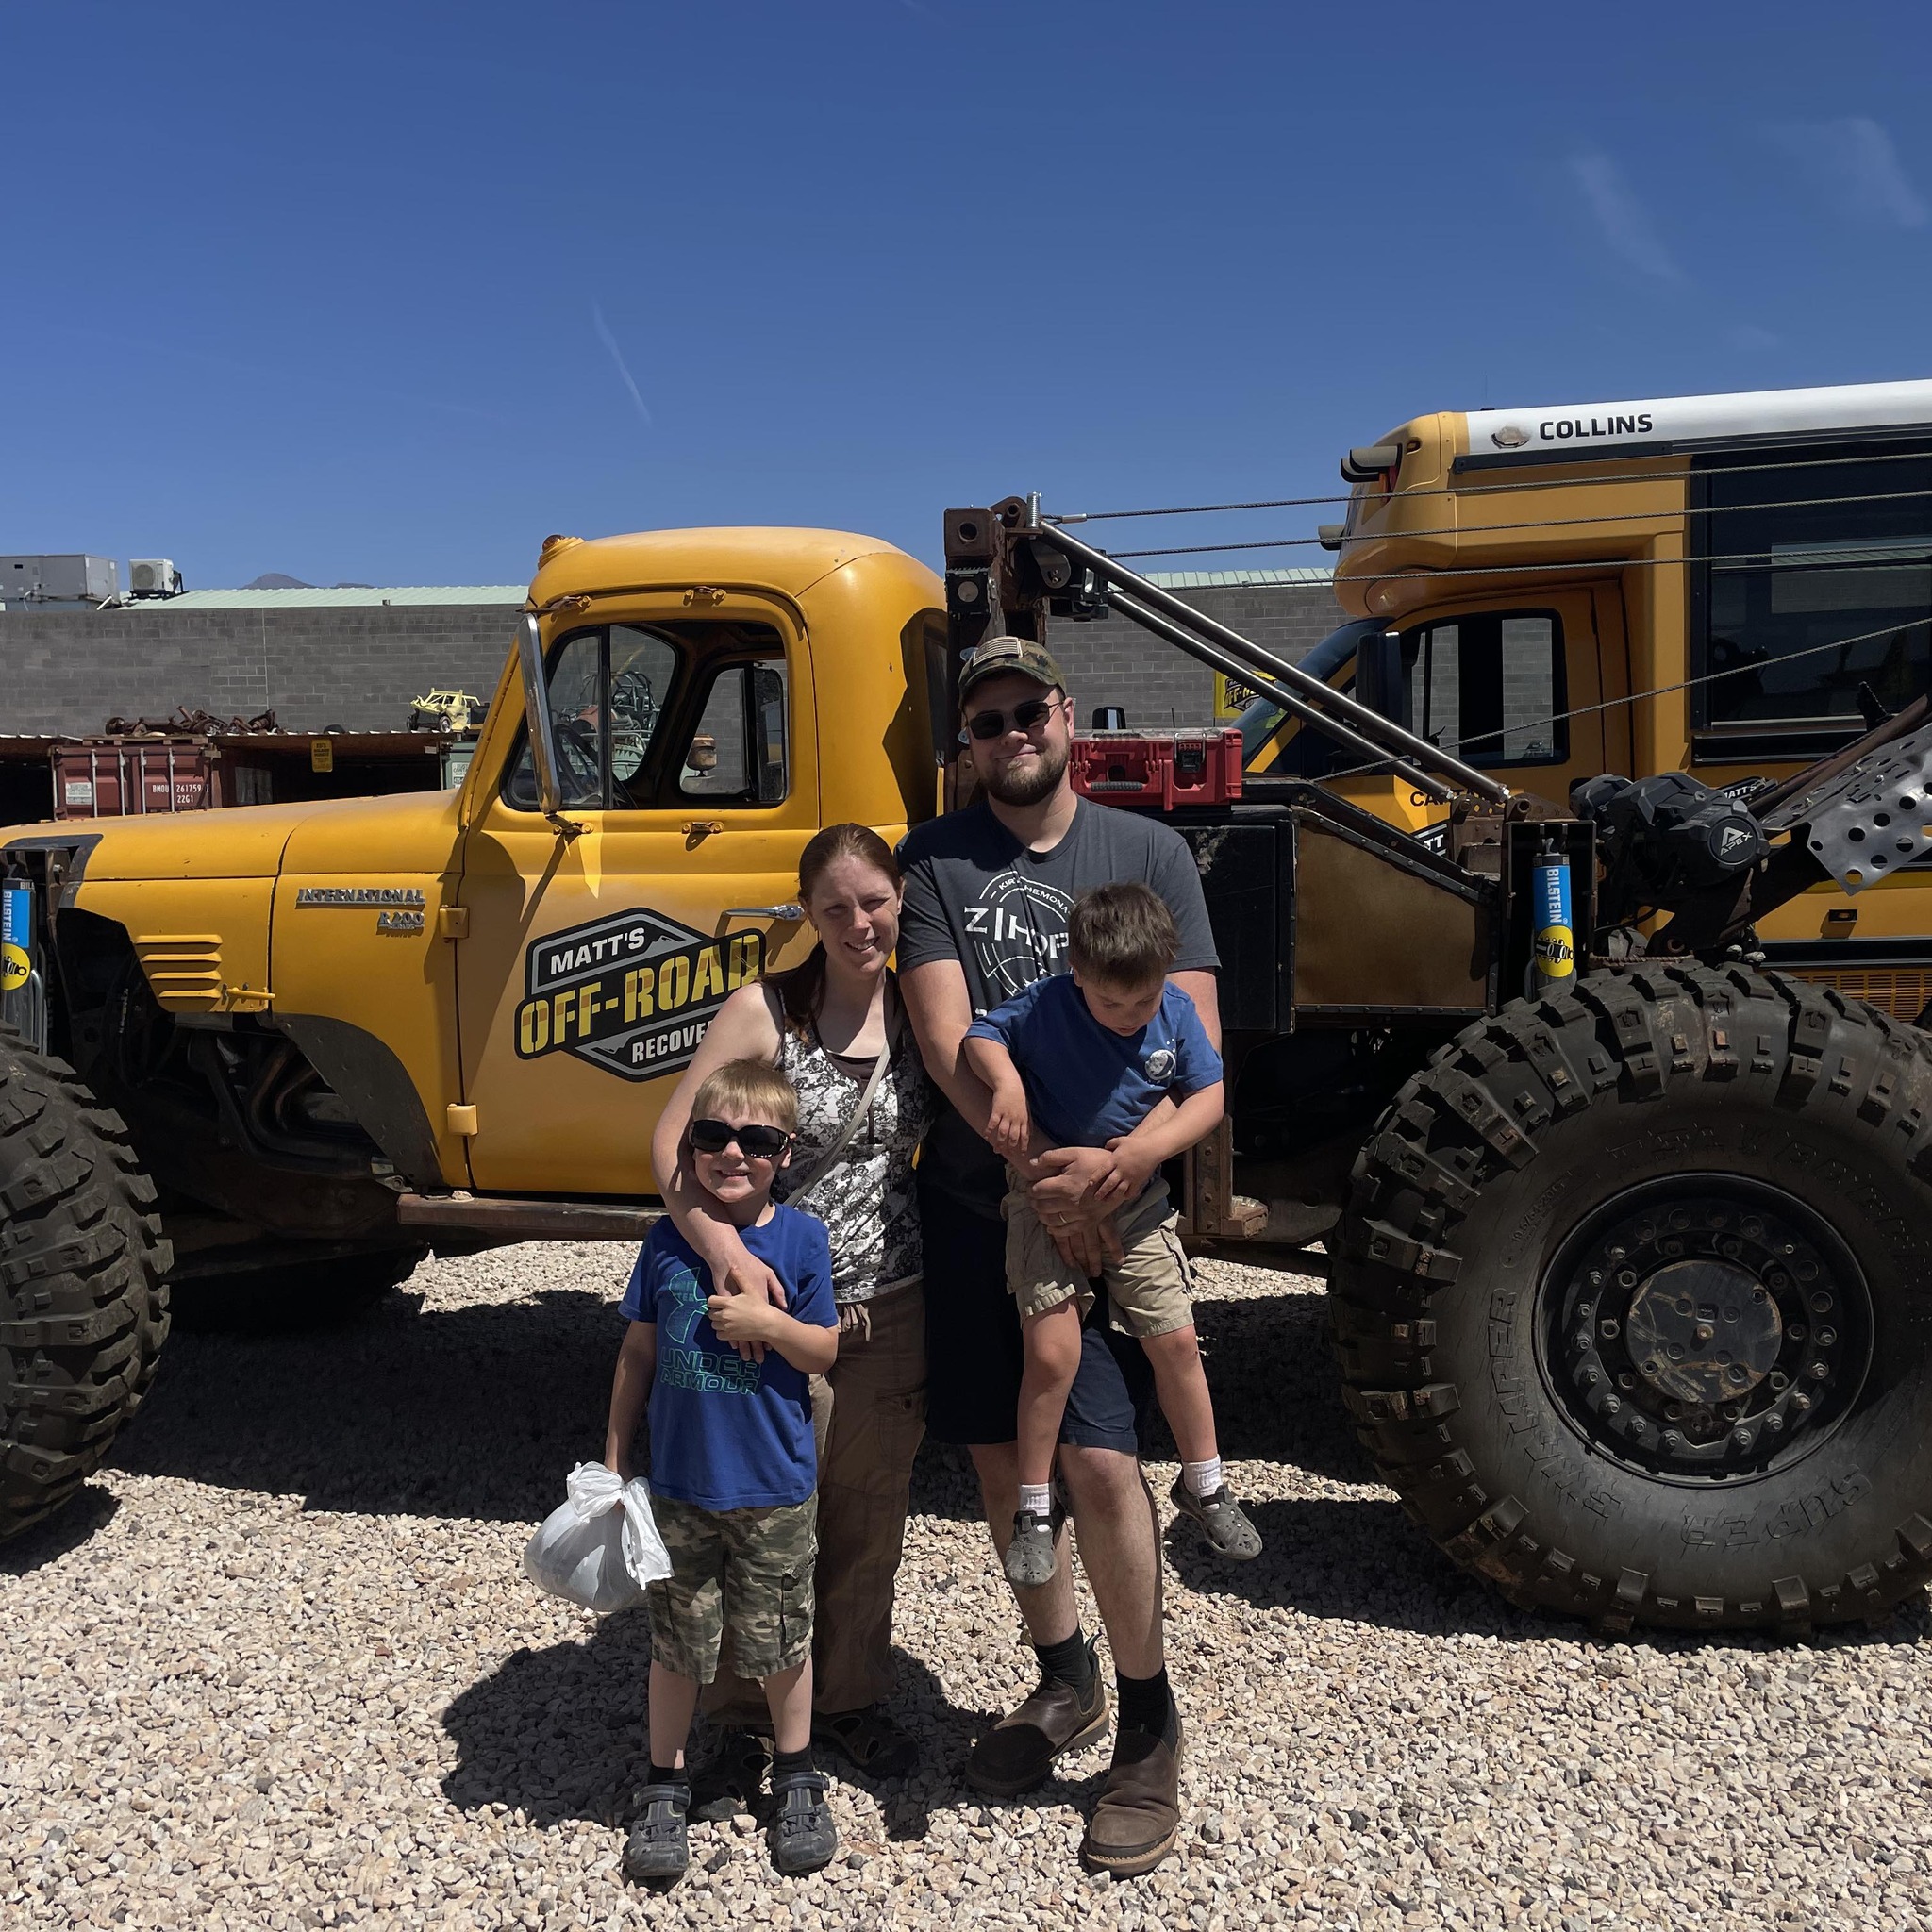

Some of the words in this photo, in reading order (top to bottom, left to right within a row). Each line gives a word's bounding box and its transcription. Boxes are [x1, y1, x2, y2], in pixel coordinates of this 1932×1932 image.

[1540, 414, 1653, 441] COLLINS
[176, 784, 202, 793] 261759
[176, 795, 194, 804] 22G1
[1720, 831, 1754, 856] APEX
[297, 889, 426, 903] INTERNATIONAL
[1547, 868, 1562, 924] BILSTEIN
[3, 891, 13, 941] BILSTEIN
[550, 927, 645, 975] MATT'S
[520, 934, 759, 1054] OFF-ROAD
[631, 1020, 711, 1063] RECOVE
[661, 1346, 761, 1378] UNDER
[661, 1367, 758, 1395] ARMOUR
